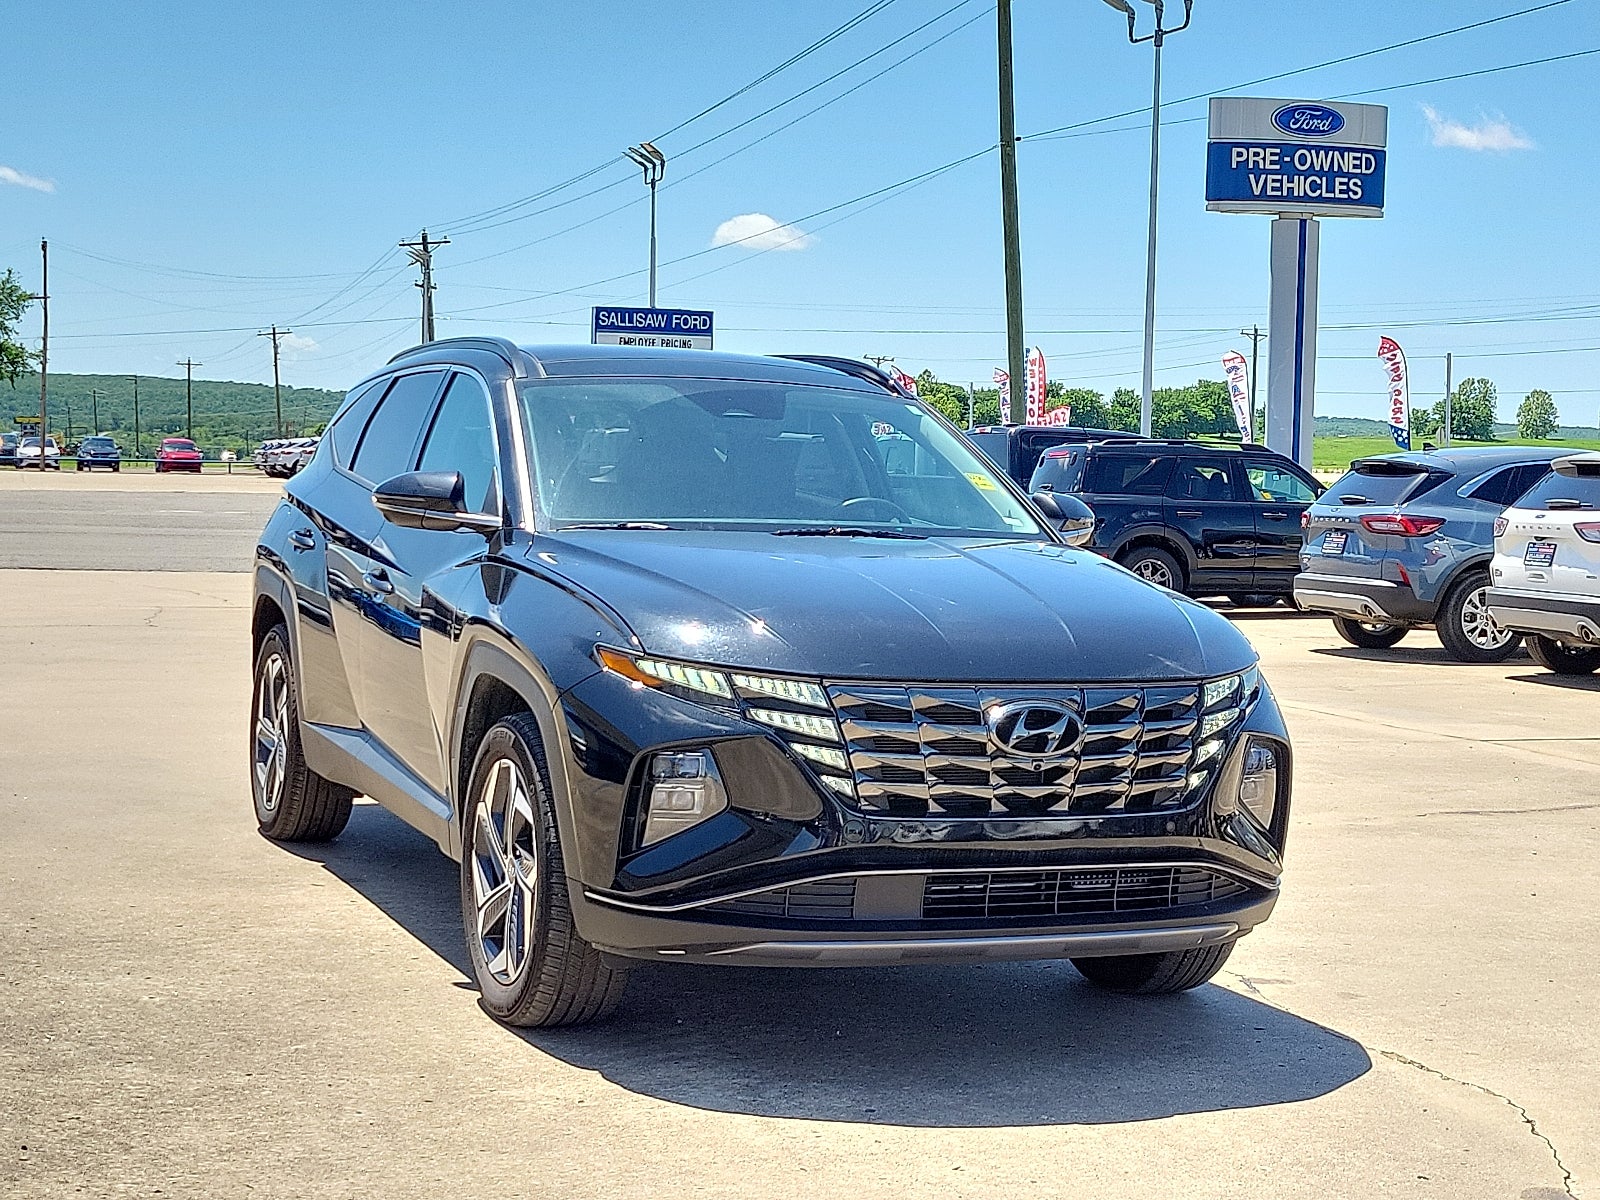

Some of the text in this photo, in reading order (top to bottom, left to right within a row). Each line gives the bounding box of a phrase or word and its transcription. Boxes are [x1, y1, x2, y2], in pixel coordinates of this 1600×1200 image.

[1289, 108, 1333, 132] Ford
[1249, 174, 1362, 199] VEHICLES
[599, 312, 711, 330] SALLISAW FORD
[660, 338, 693, 348] PRICING
